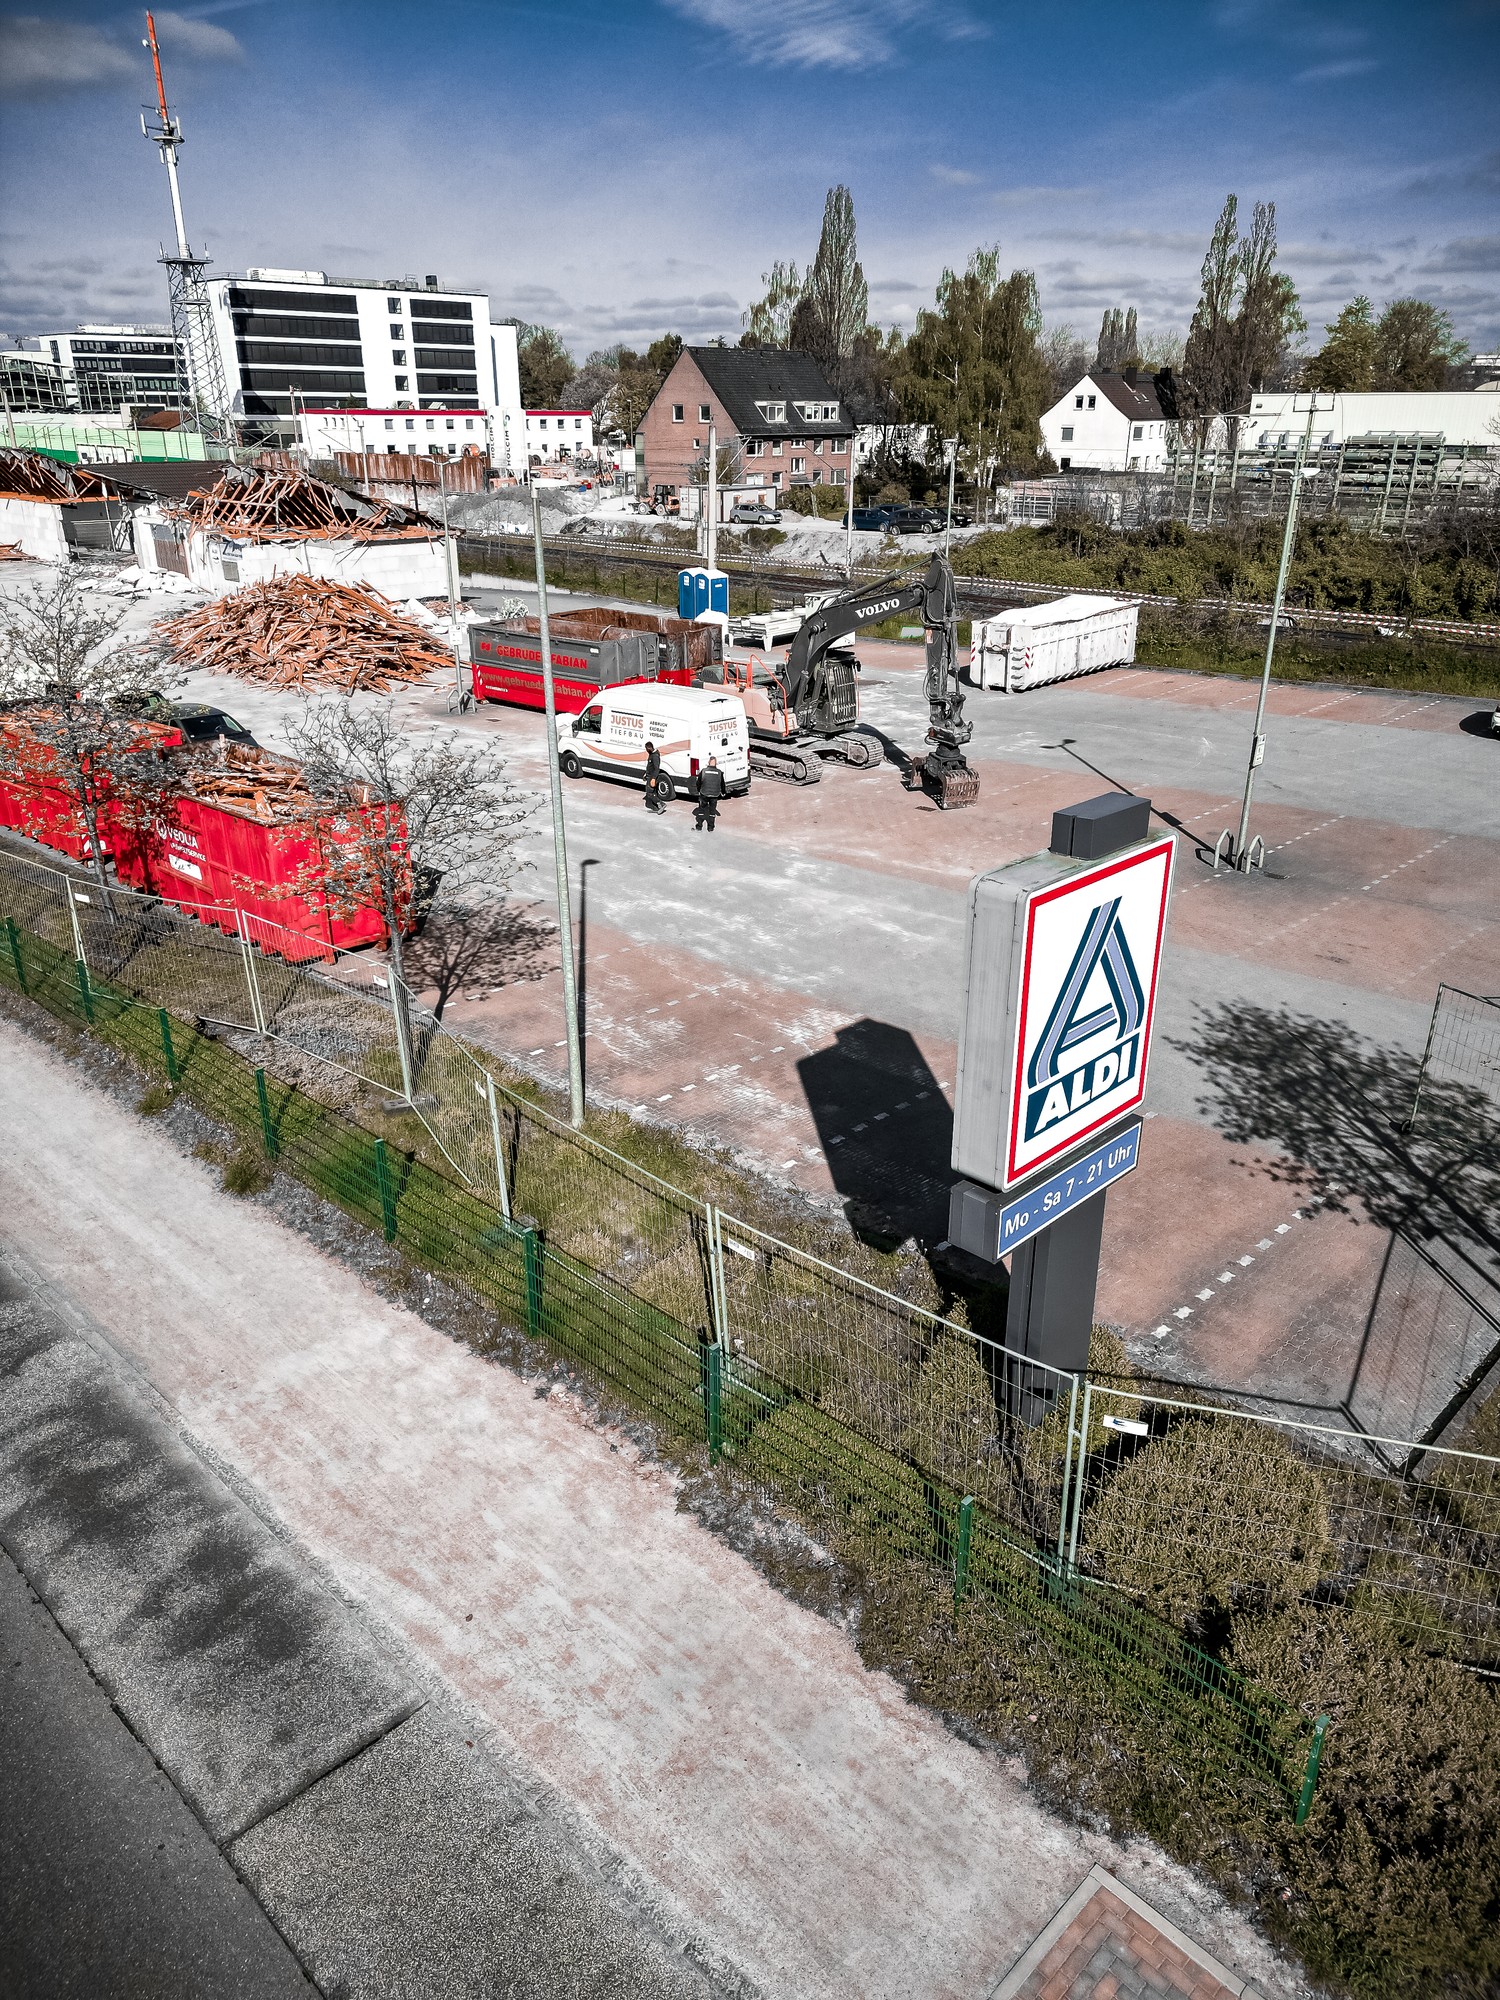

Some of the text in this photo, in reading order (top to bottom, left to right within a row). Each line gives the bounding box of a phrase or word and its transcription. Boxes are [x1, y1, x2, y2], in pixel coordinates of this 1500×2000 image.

[855, 598, 900, 619] VOLVO
[550, 652, 588, 669] FABIAN
[610, 714, 644, 729] JUSTUS
[709, 720, 738, 733] JUSTUS
[610, 728, 644, 739] TIEFBAU
[167, 826, 199, 850] VEOLIA
[1034, 1040, 1133, 1134] ALDI
[1004, 1212, 1030, 1238] Mo
[1043, 1191, 1061, 1213] Sa
[1065, 1177, 1076, 1198] 7
[1086, 1158, 1104, 1185] 21
[1107, 1143, 1133, 1169] Uhr
